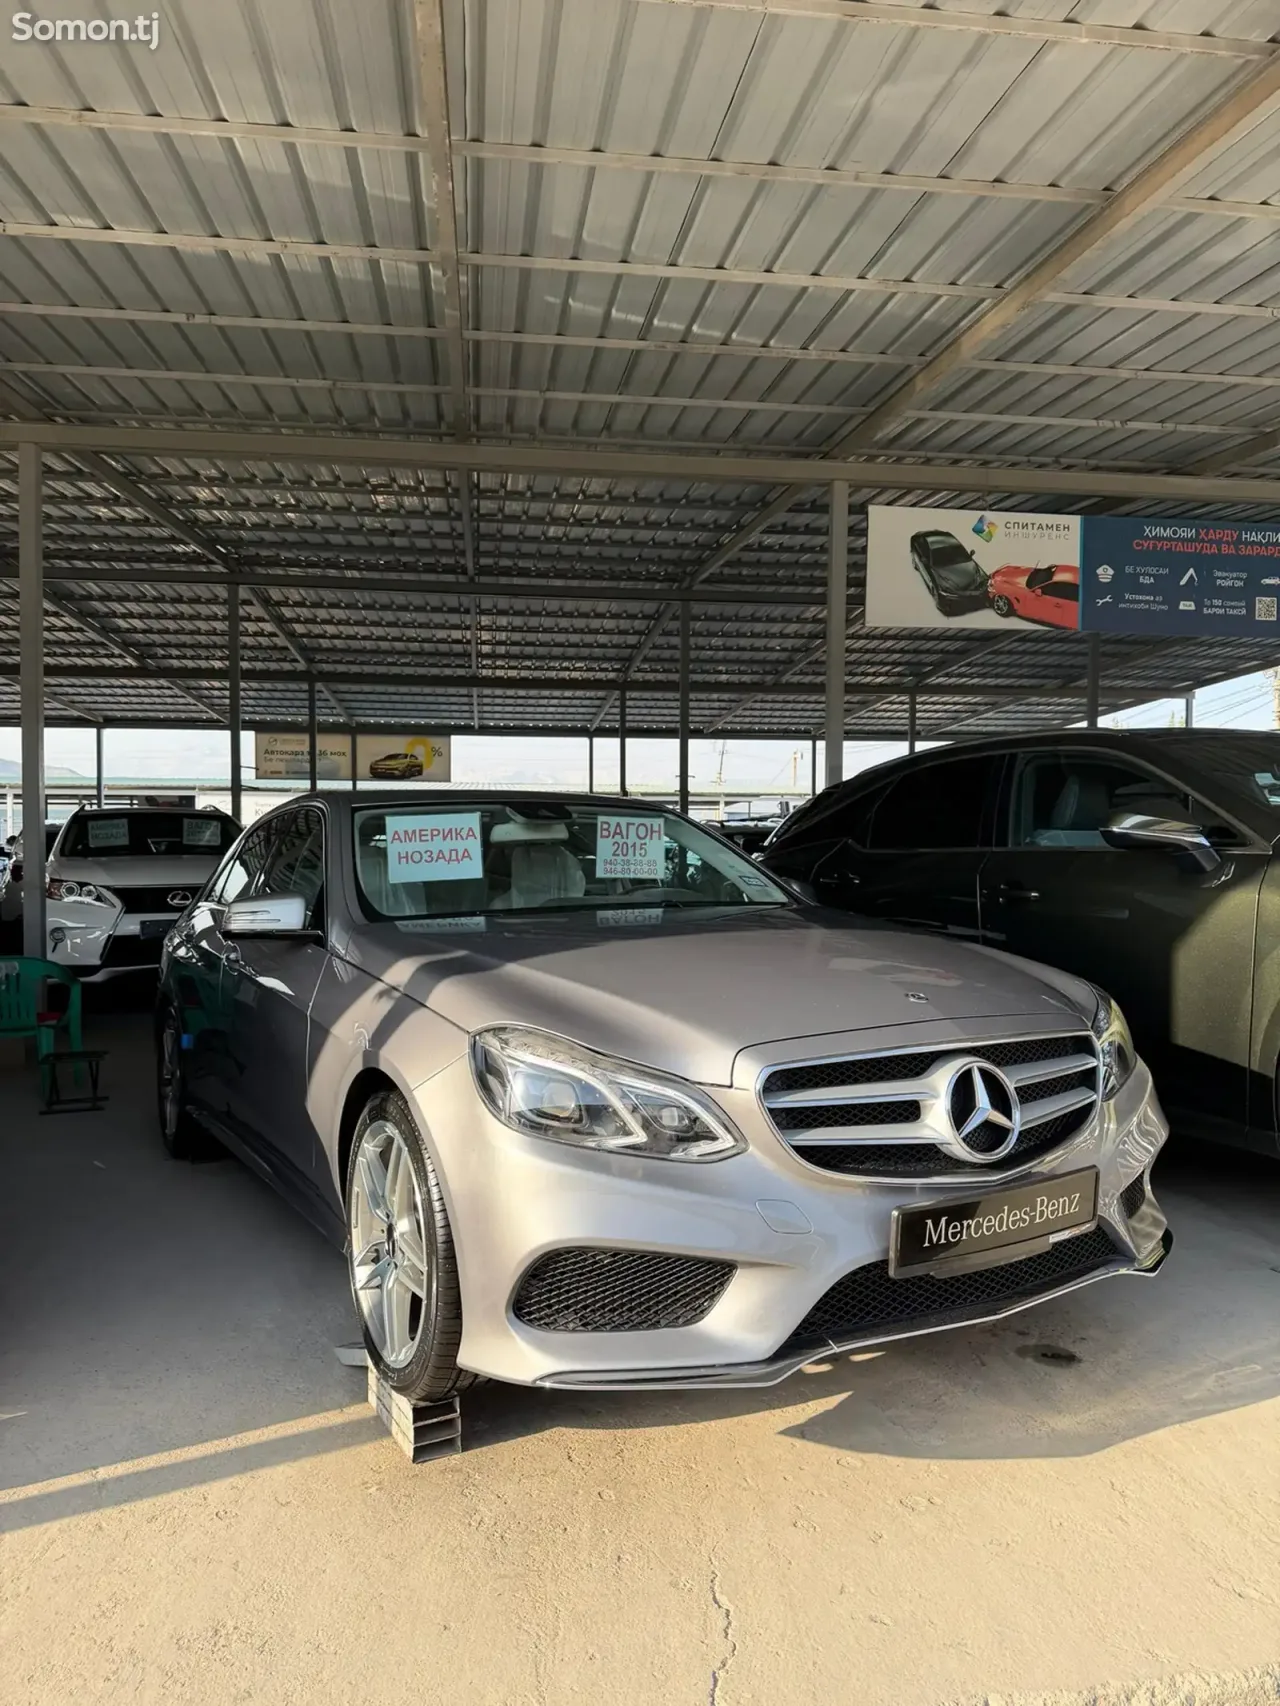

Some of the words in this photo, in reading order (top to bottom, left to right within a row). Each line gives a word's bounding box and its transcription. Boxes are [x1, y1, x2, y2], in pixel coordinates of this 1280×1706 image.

[1004, 521, 1070, 532] СПИТАМЕН
[1004, 531, 1069, 540] ИНШУРЕНС
[1221, 545, 1235, 555] ВА
[391, 827, 477, 844] АМЕРИКА
[600, 821, 661, 840] ВАГОН
[398, 848, 472, 865] НОЗАДА
[612, 841, 647, 857] 2015
[923, 1193, 1080, 1247] Mercedes-Benz
